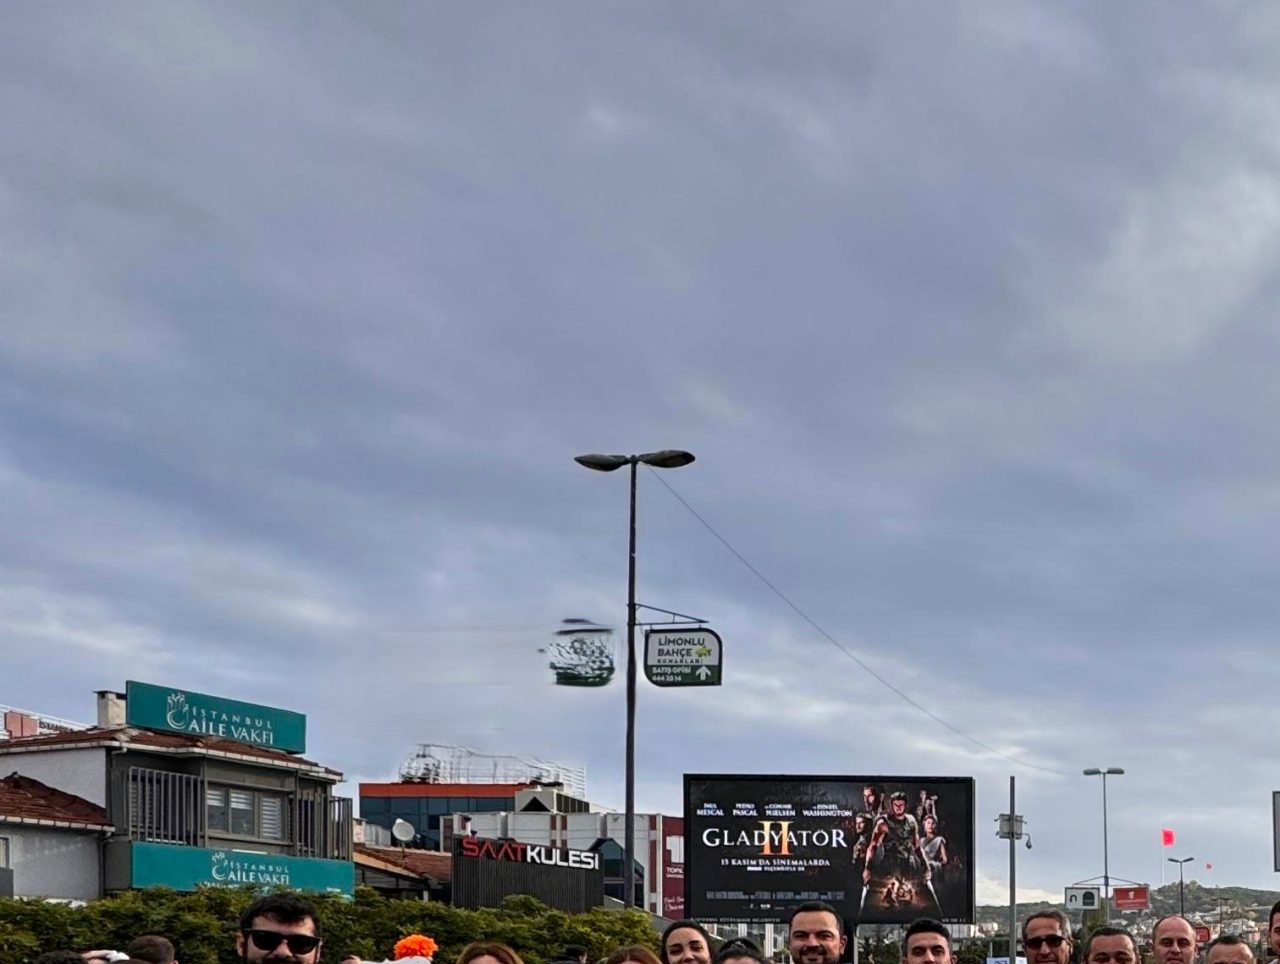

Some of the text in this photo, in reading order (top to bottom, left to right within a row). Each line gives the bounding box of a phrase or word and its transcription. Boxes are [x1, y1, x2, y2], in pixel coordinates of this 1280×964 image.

[657, 648, 693, 658] BAHÇE
[189, 717, 273, 745] AİLE VAKFI
[702, 828, 848, 848] GLADYATÖR
[228, 867, 289, 885] AİLE VAKFI
